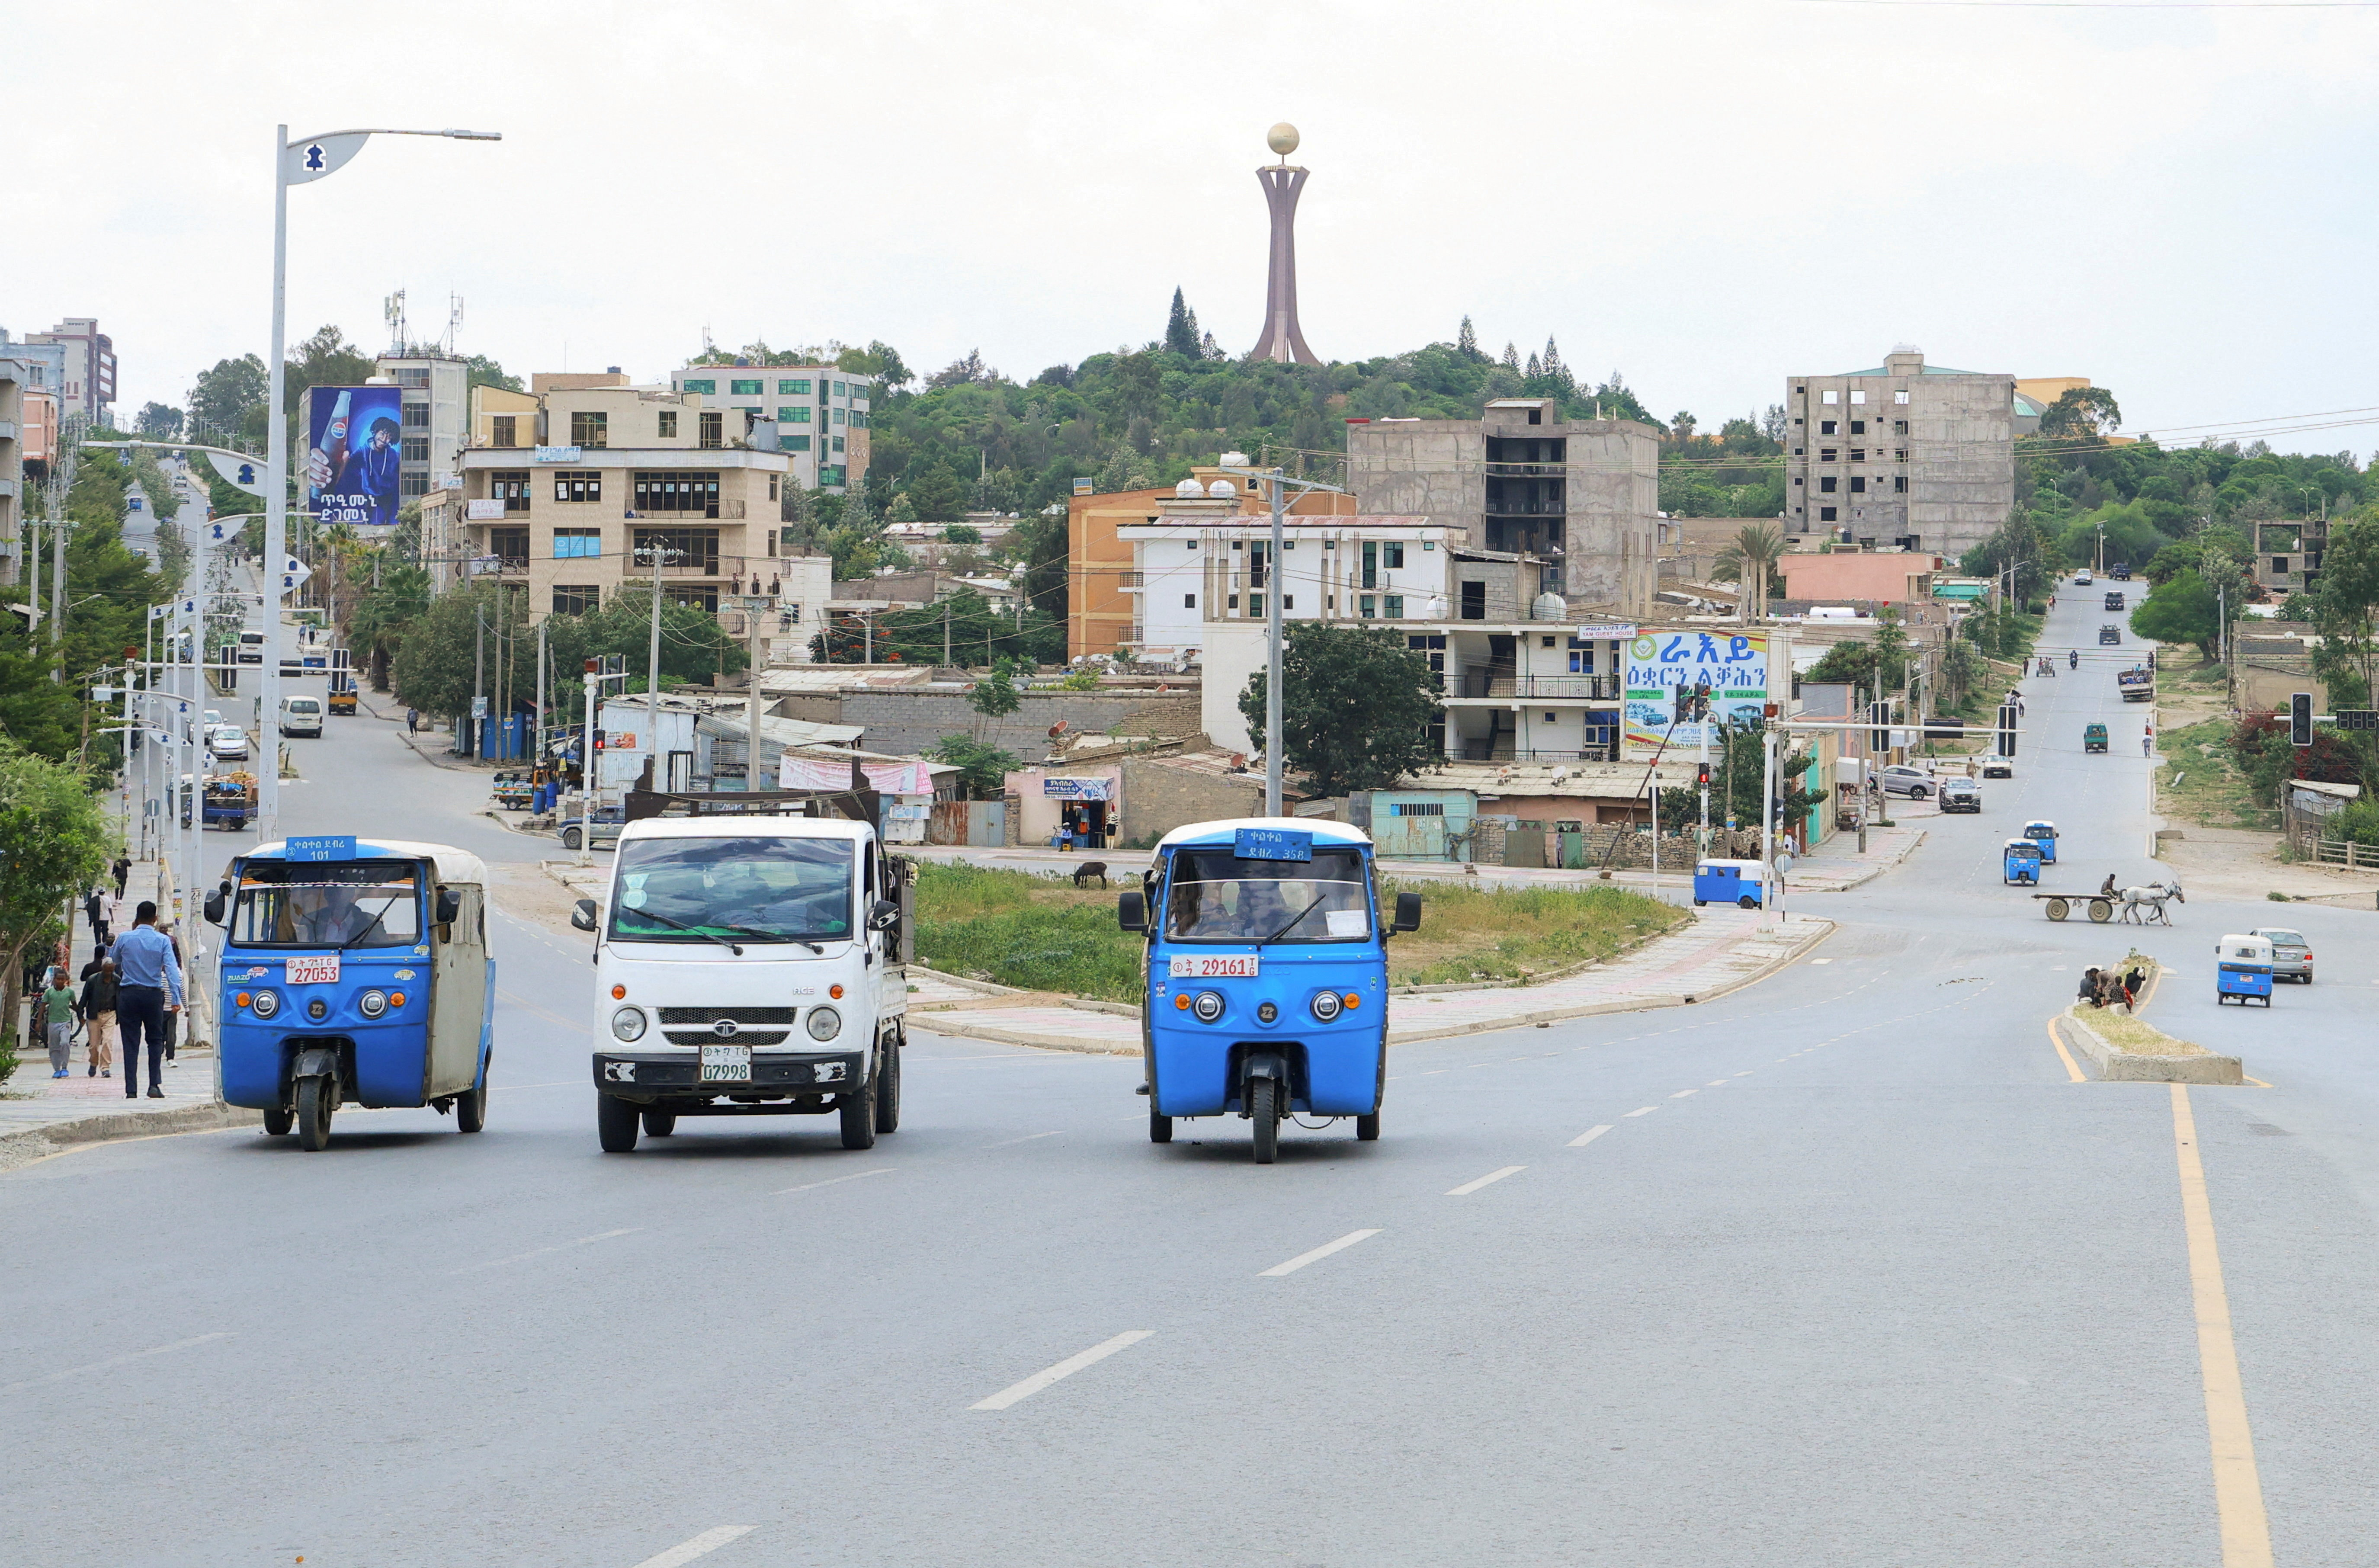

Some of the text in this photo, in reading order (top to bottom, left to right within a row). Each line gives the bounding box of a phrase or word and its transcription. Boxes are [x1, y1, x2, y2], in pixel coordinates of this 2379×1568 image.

[321, 494, 377, 507] ጥዒሙኒ
[320, 509, 369, 521] ድገመኒ
[1661, 633, 1754, 664] ራእይ
[1627, 666, 1687, 688] ዕቋርን
[1237, 830, 1244, 838] 3
[311, 850, 329, 860] 101
[1202, 959, 1245, 975] 29161
[295, 967, 337, 982] 27053
[793, 986, 815, 995] ACE
[704, 1065, 747, 1080] 07998
